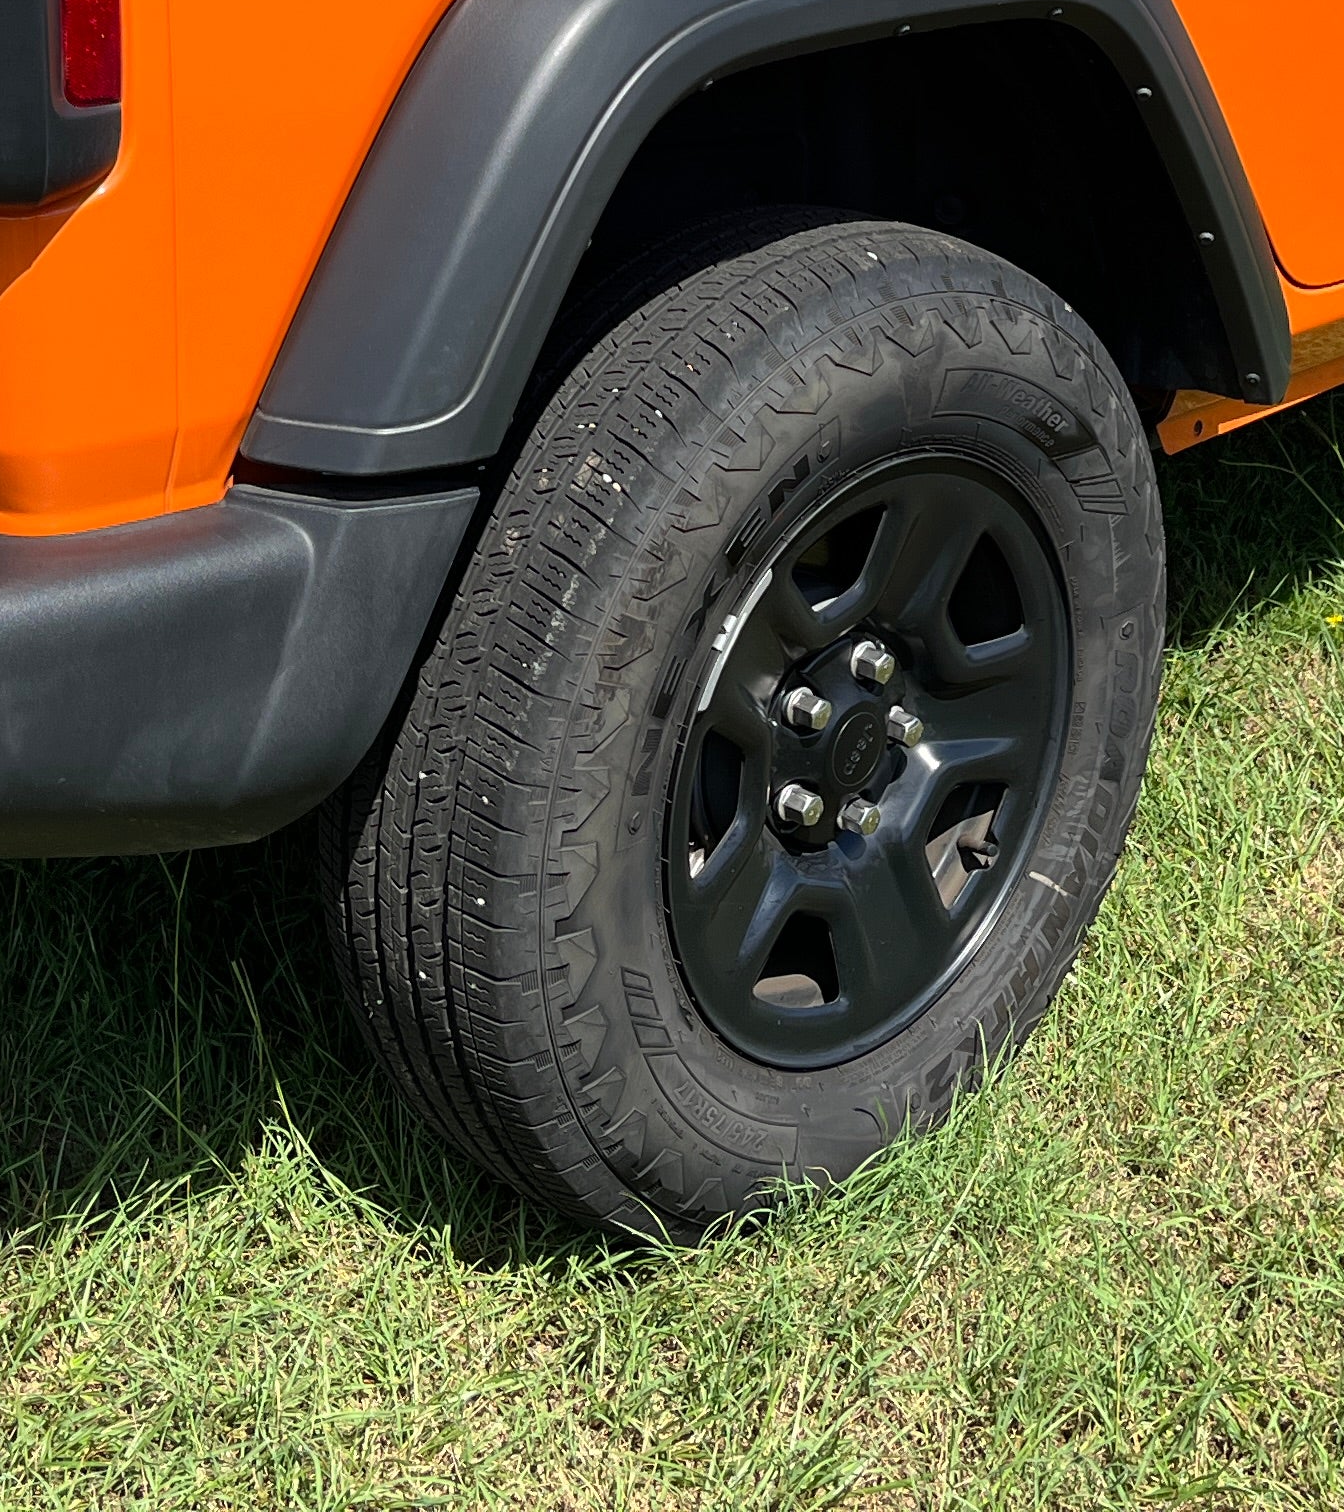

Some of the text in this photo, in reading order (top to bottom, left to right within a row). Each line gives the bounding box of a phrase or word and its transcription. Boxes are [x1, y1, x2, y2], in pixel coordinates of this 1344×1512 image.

[960, 371, 1069, 433] All-Weather
[631, 454, 811, 796] NEXEN
[843, 723, 873, 776] Jeep
[673, 1080, 769, 1151] 245/75R17
